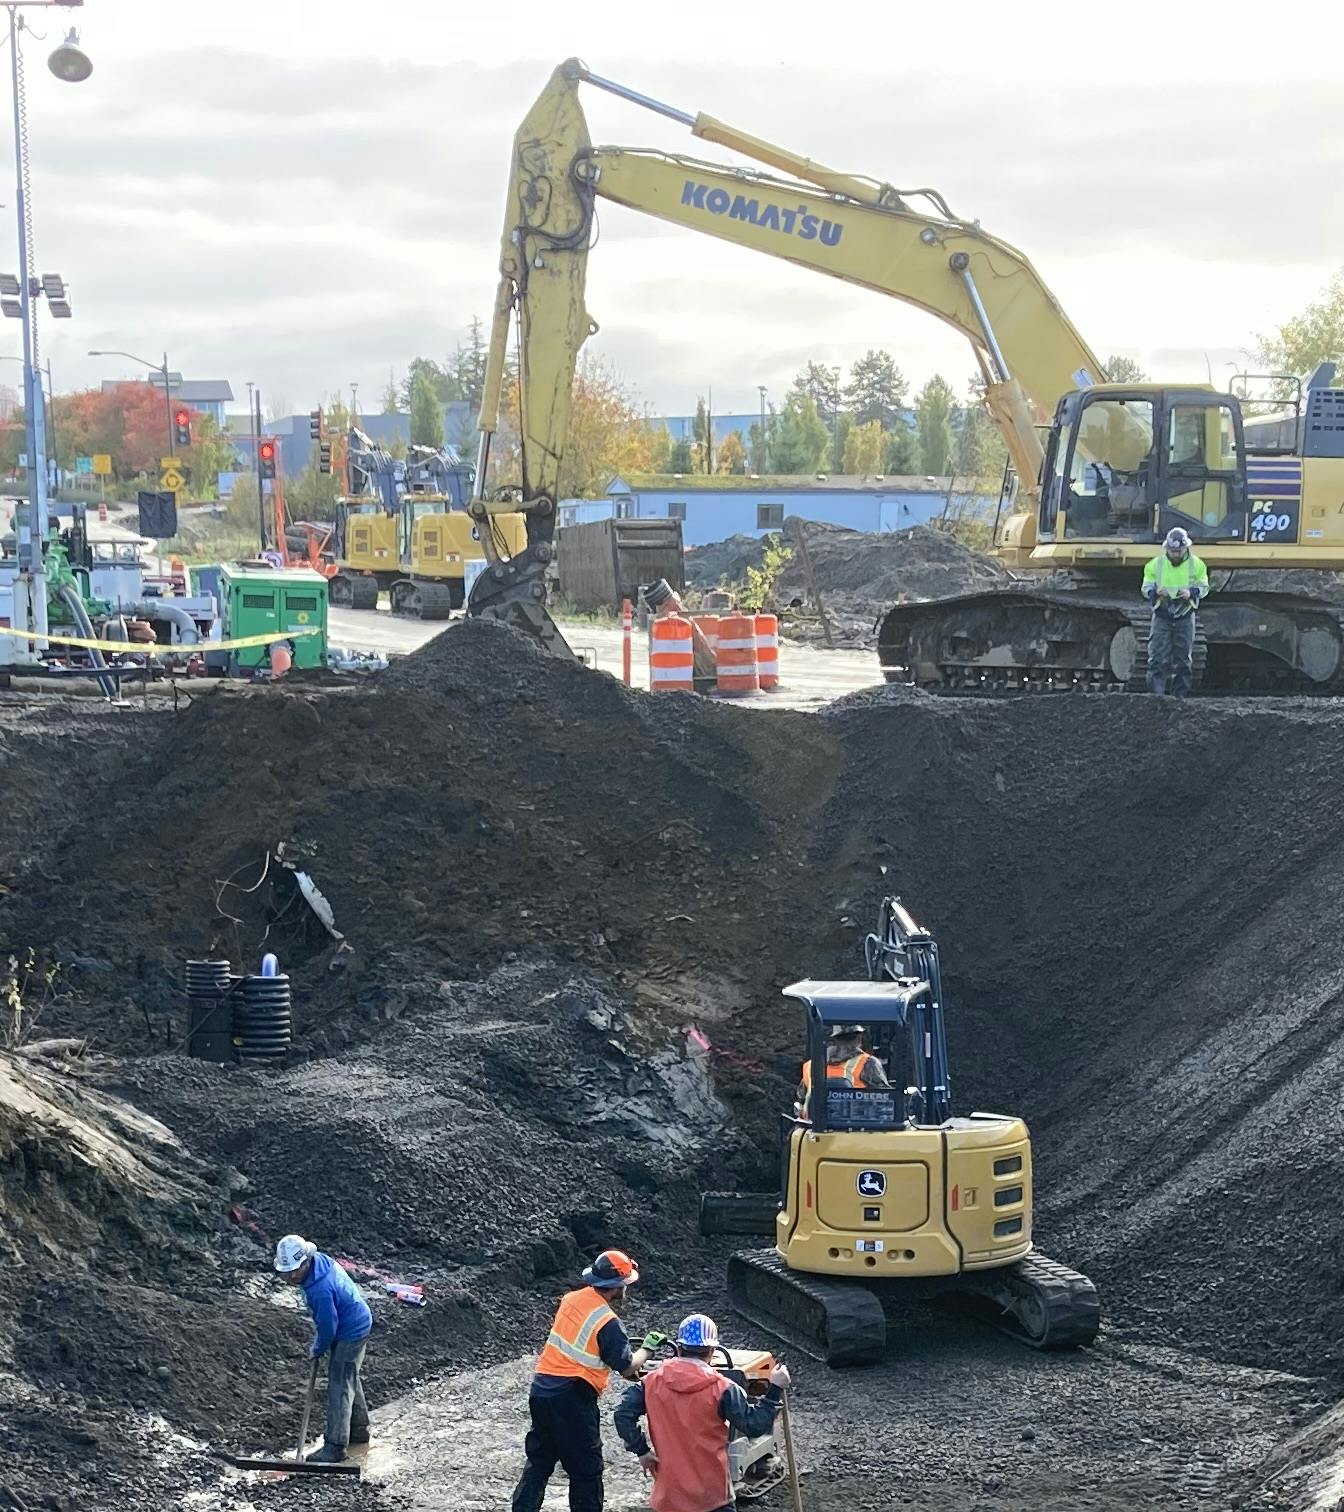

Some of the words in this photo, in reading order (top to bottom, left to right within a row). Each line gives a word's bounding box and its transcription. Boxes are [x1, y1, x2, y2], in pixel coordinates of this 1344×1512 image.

[681, 180, 844, 247] KOMATSU
[1251, 500, 1274, 513] PC
[1250, 514, 1291, 531] 490
[1250, 530, 1266, 542] LC
[826, 1091, 854, 1100] JOHN
[855, 1091, 890, 1101] DEERE
